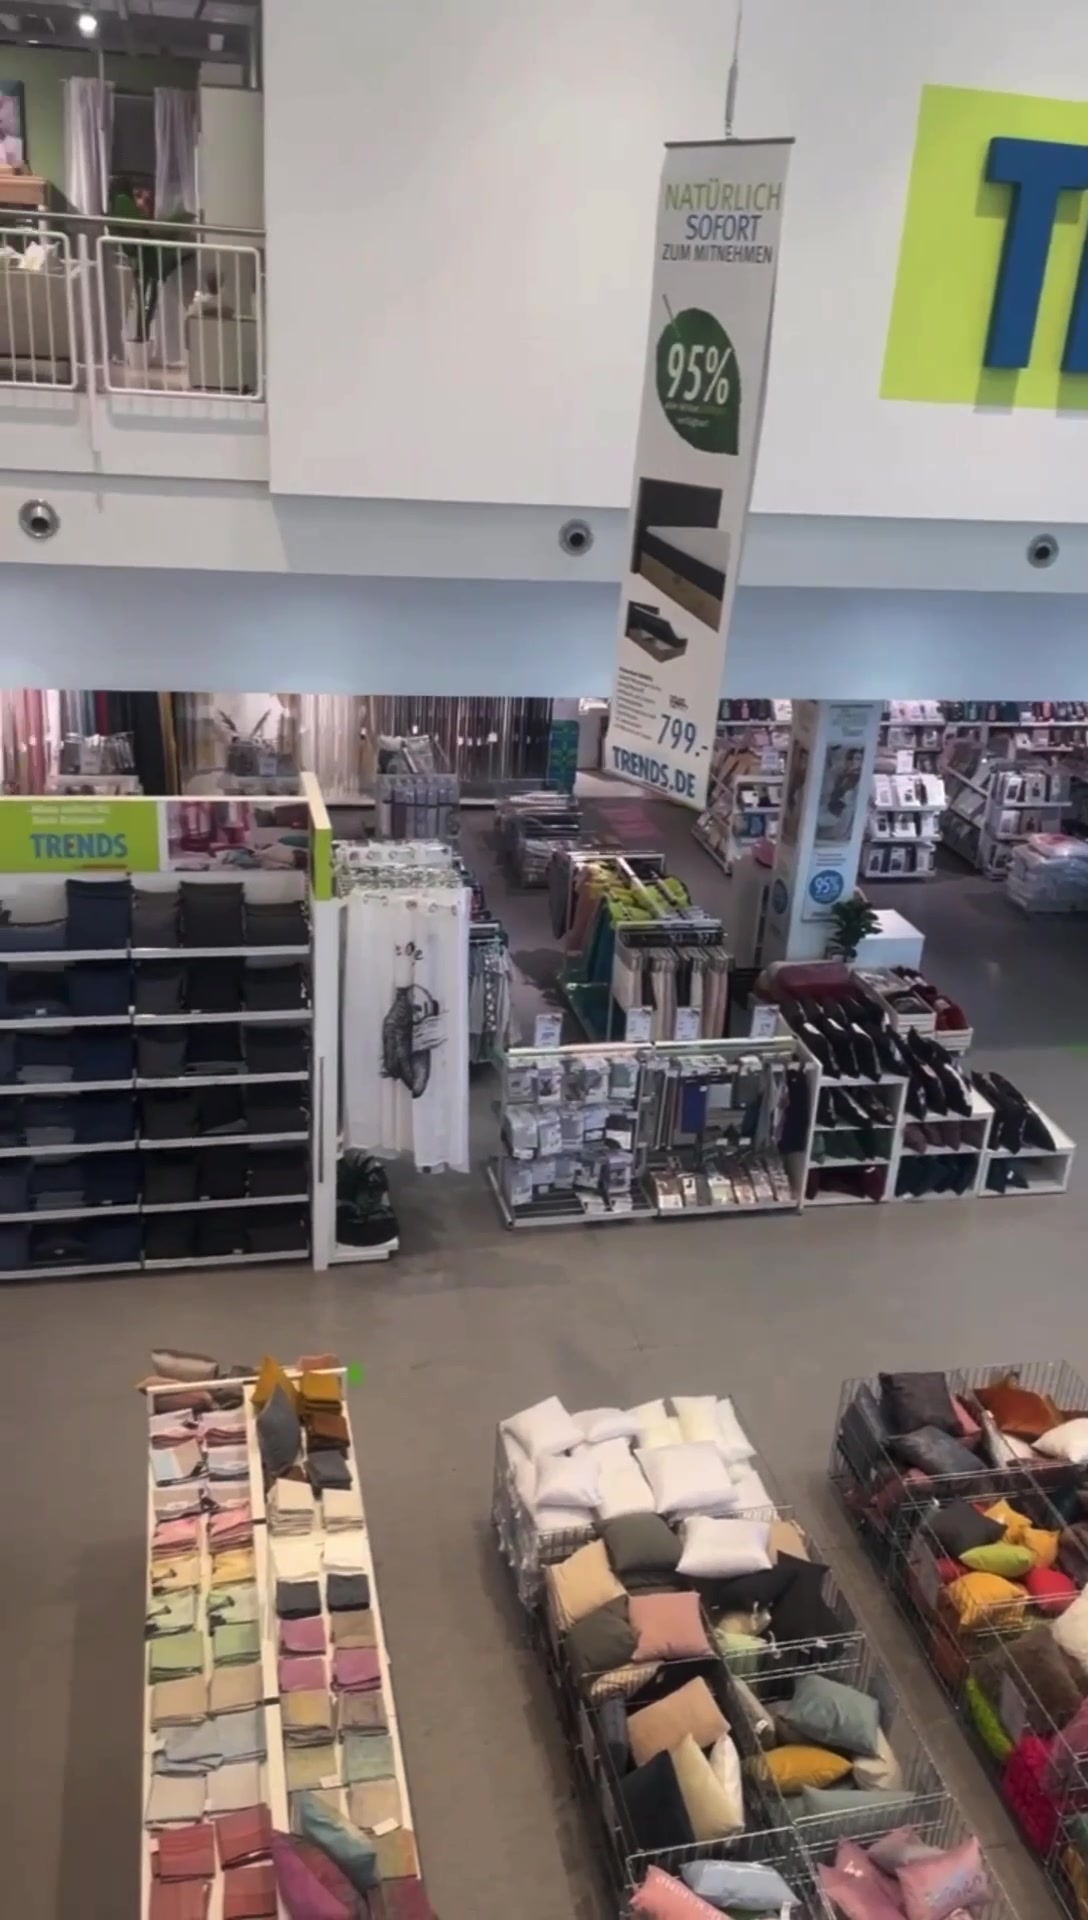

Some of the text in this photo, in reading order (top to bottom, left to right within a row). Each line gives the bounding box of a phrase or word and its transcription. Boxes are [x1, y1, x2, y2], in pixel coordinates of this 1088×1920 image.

[664, 177, 782, 211] NATÜRLICH
[685, 213, 762, 241] SOFORT
[662, 243, 774, 264] ZUM MITNEHMEN
[982, 135, 1088, 373] T
[667, 342, 732, 405] 95%
[657, 713, 709, 757] 799.-
[612, 744, 697, 799] TRENDS.DE
[30, 832, 129, 859] TRENDS
